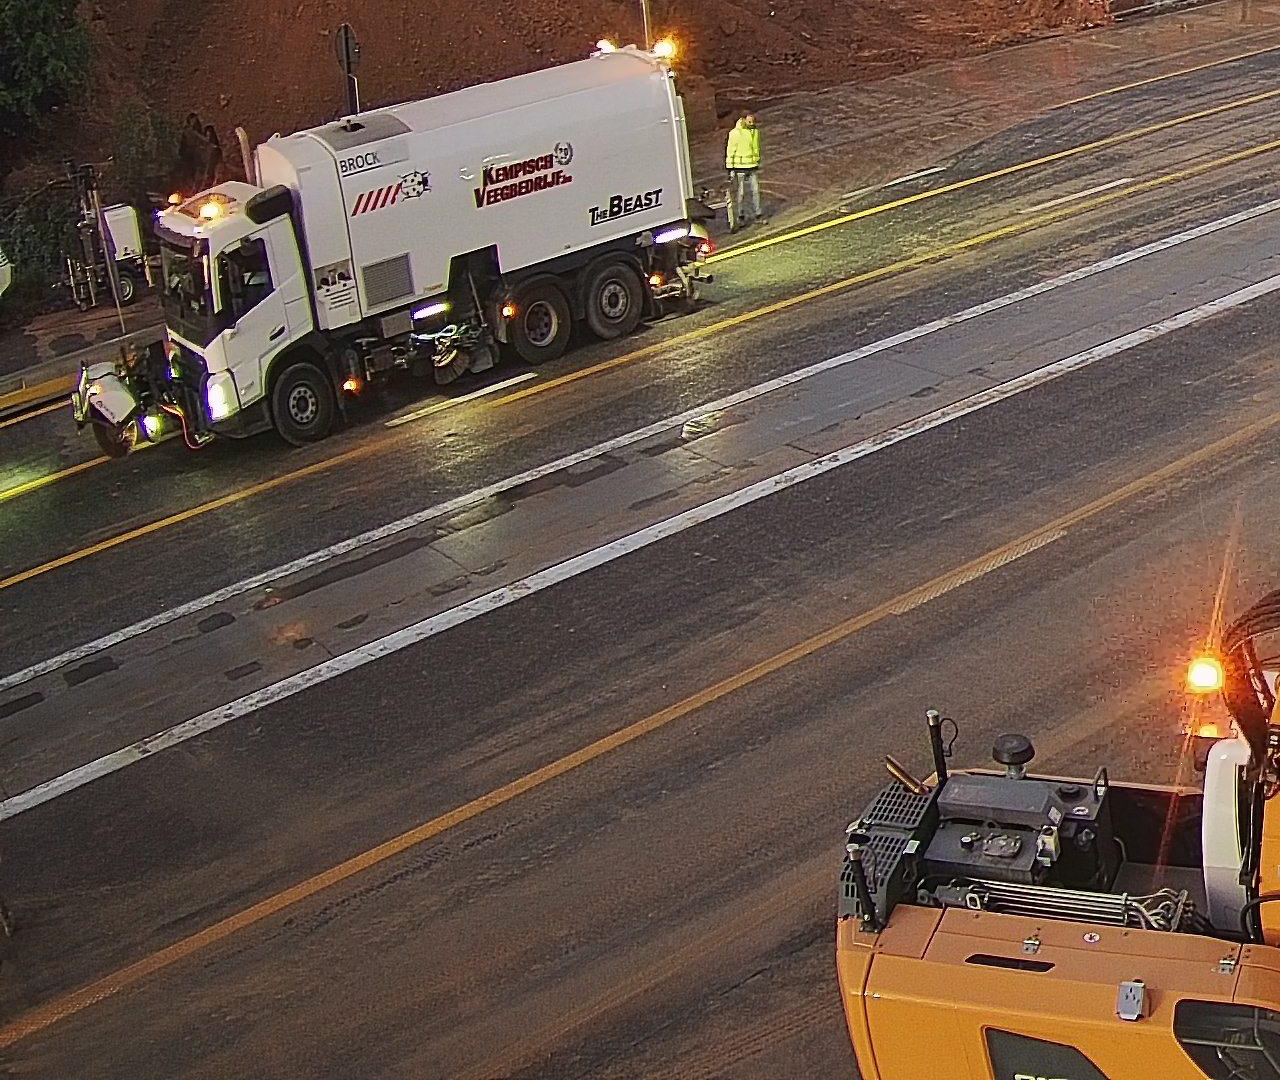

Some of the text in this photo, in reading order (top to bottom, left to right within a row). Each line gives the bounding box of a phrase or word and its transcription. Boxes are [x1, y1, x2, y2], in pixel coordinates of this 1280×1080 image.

[339, 152, 381, 173] BROCK
[482, 153, 554, 188] KEMPISCH
[474, 169, 564, 209] VEEGBEDRIJF
[608, 188, 663, 218] BEAST
